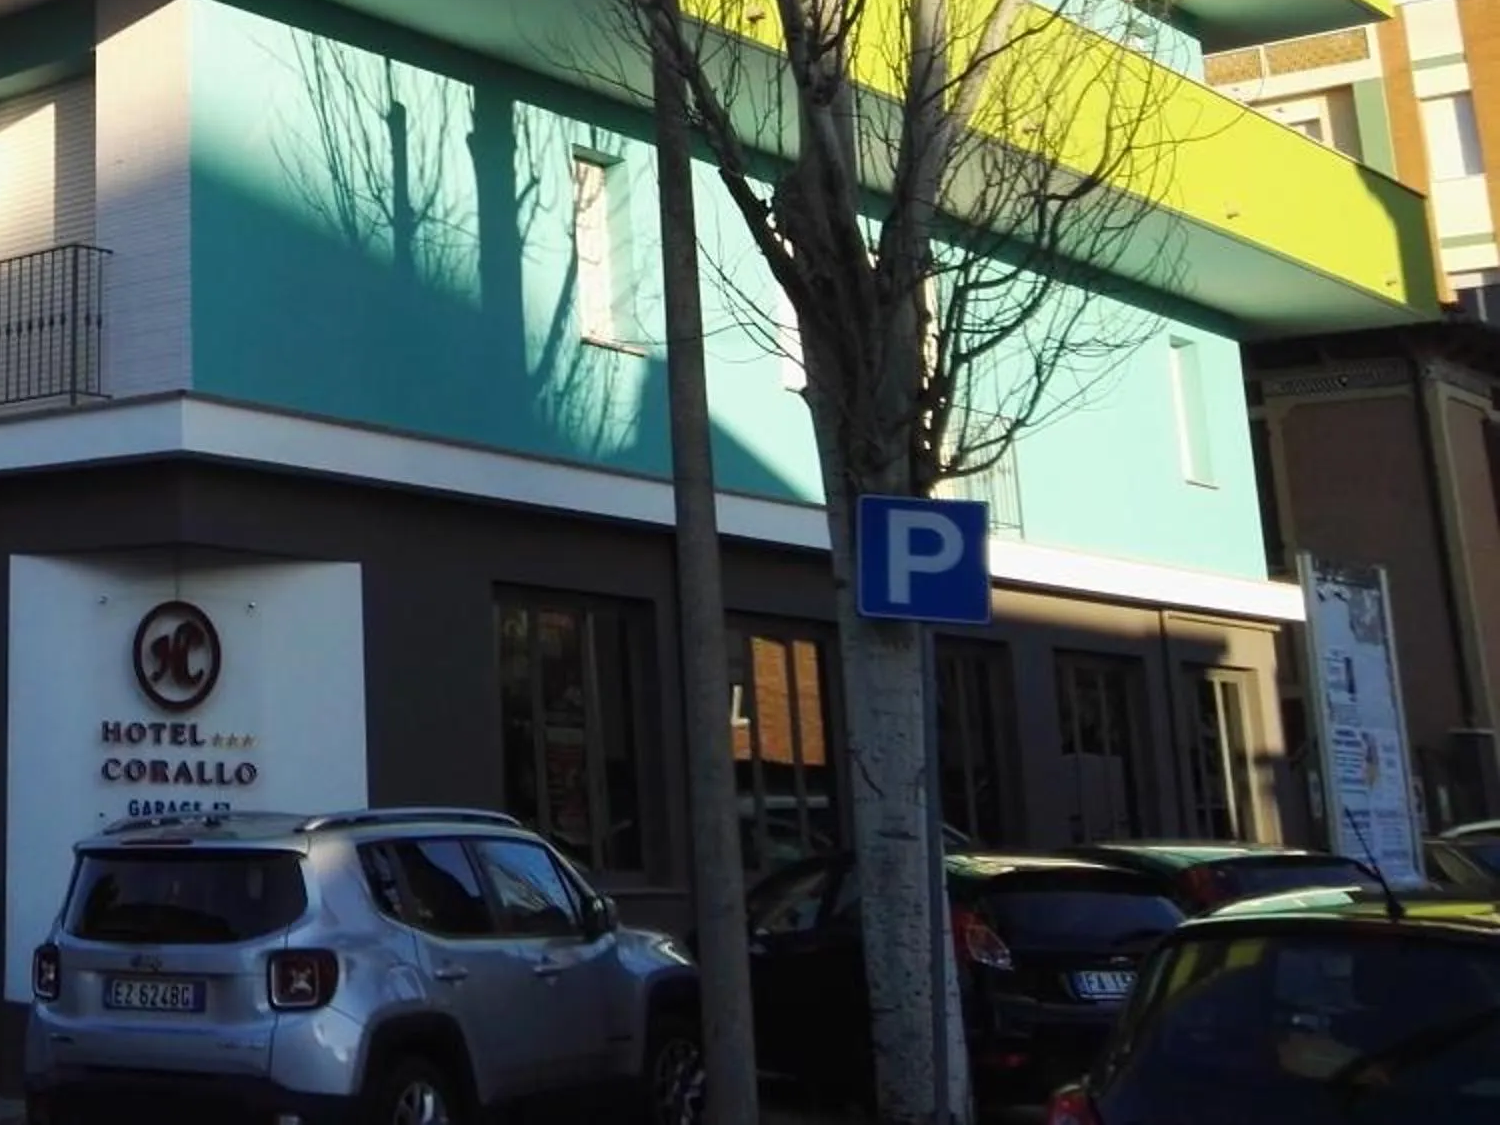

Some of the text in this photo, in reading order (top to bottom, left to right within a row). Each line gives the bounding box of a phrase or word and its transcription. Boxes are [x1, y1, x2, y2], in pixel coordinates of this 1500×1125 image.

[887, 508, 965, 605] P
[101, 721, 206, 748] HOTEL
[101, 758, 258, 786] CORALLO
